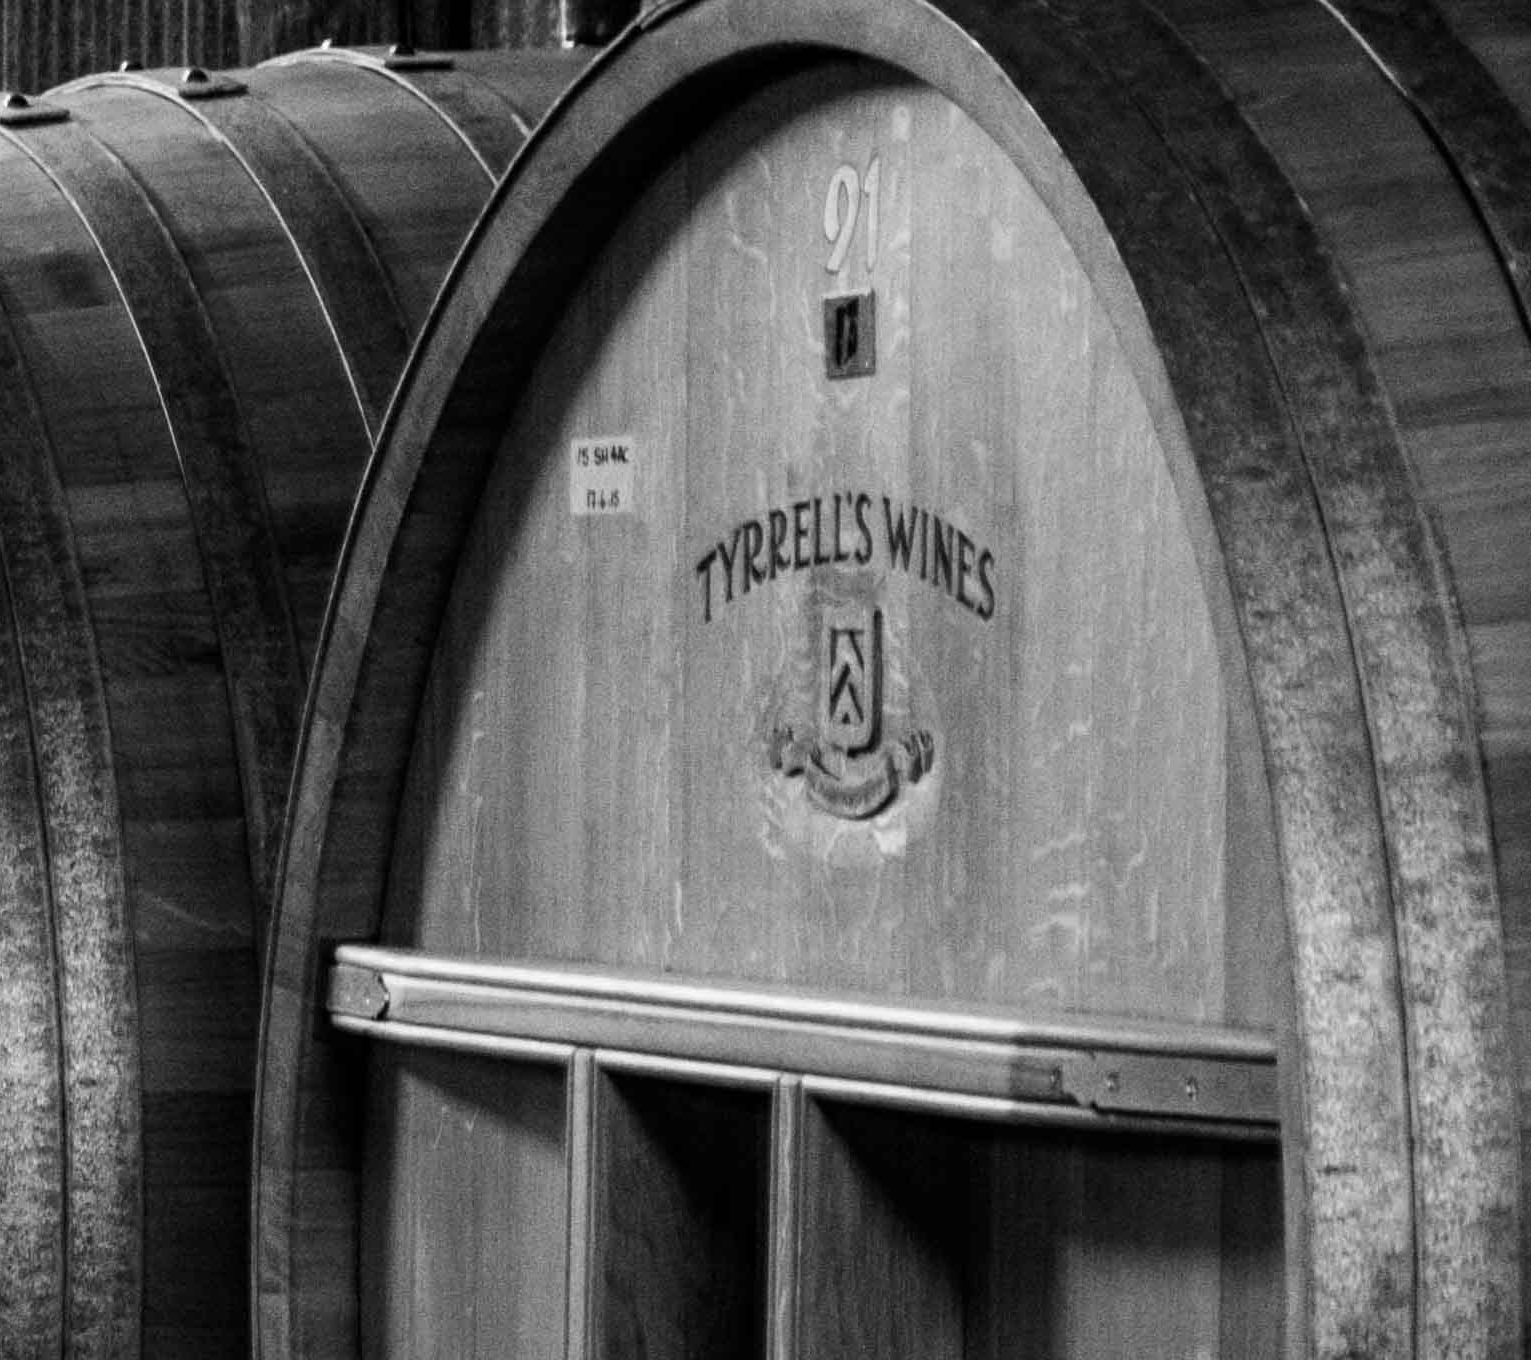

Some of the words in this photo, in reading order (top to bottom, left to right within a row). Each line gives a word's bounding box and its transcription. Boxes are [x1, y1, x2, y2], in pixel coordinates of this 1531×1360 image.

[823, 157, 879, 273] 91
[696, 490, 875, 624] TYRRELL'S
[882, 491, 996, 622] WINES
